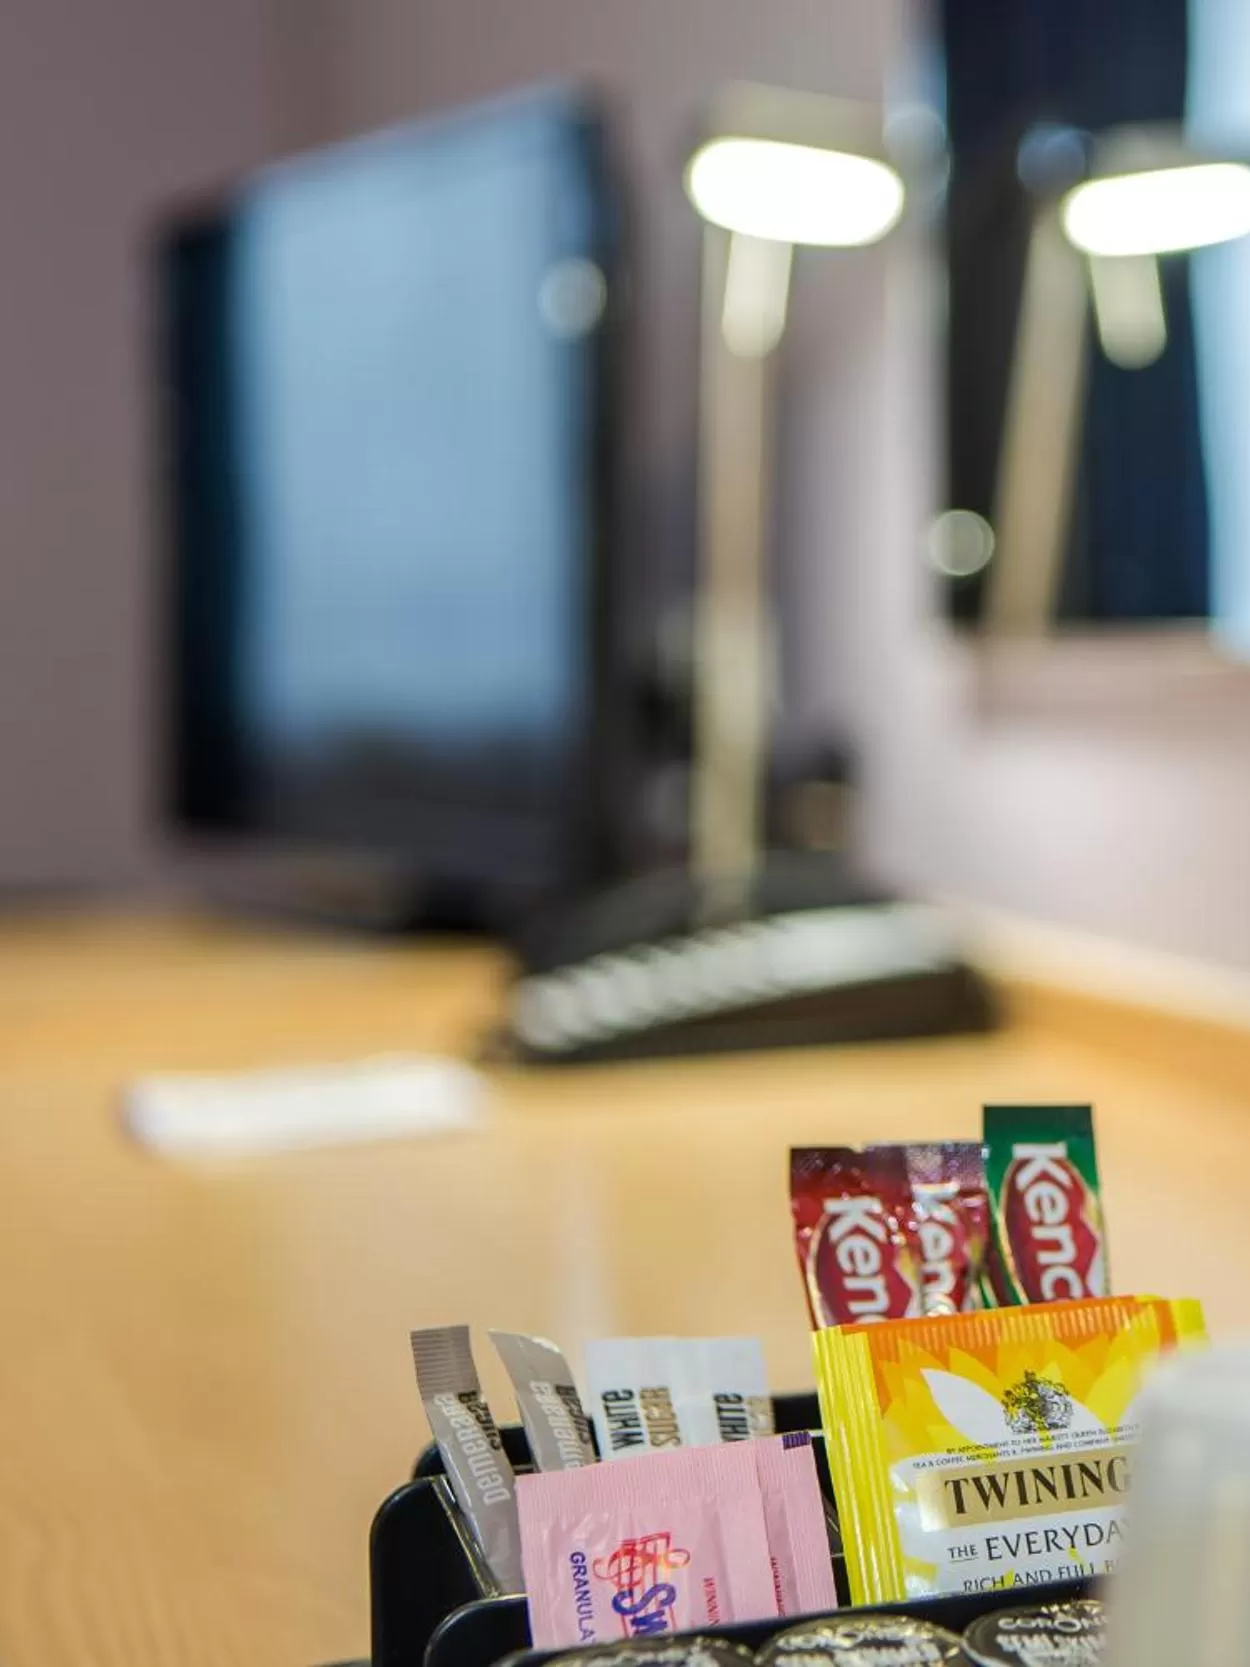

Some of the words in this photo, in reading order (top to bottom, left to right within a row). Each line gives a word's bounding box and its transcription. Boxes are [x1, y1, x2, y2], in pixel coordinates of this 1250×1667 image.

[822, 1195, 892, 1324] Ken
[948, 1544, 979, 1560] THE
[570, 1551, 597, 1642] GRANULA
[963, 1576, 1005, 1593] RICH
[1012, 1570, 1053, 1586] AND
